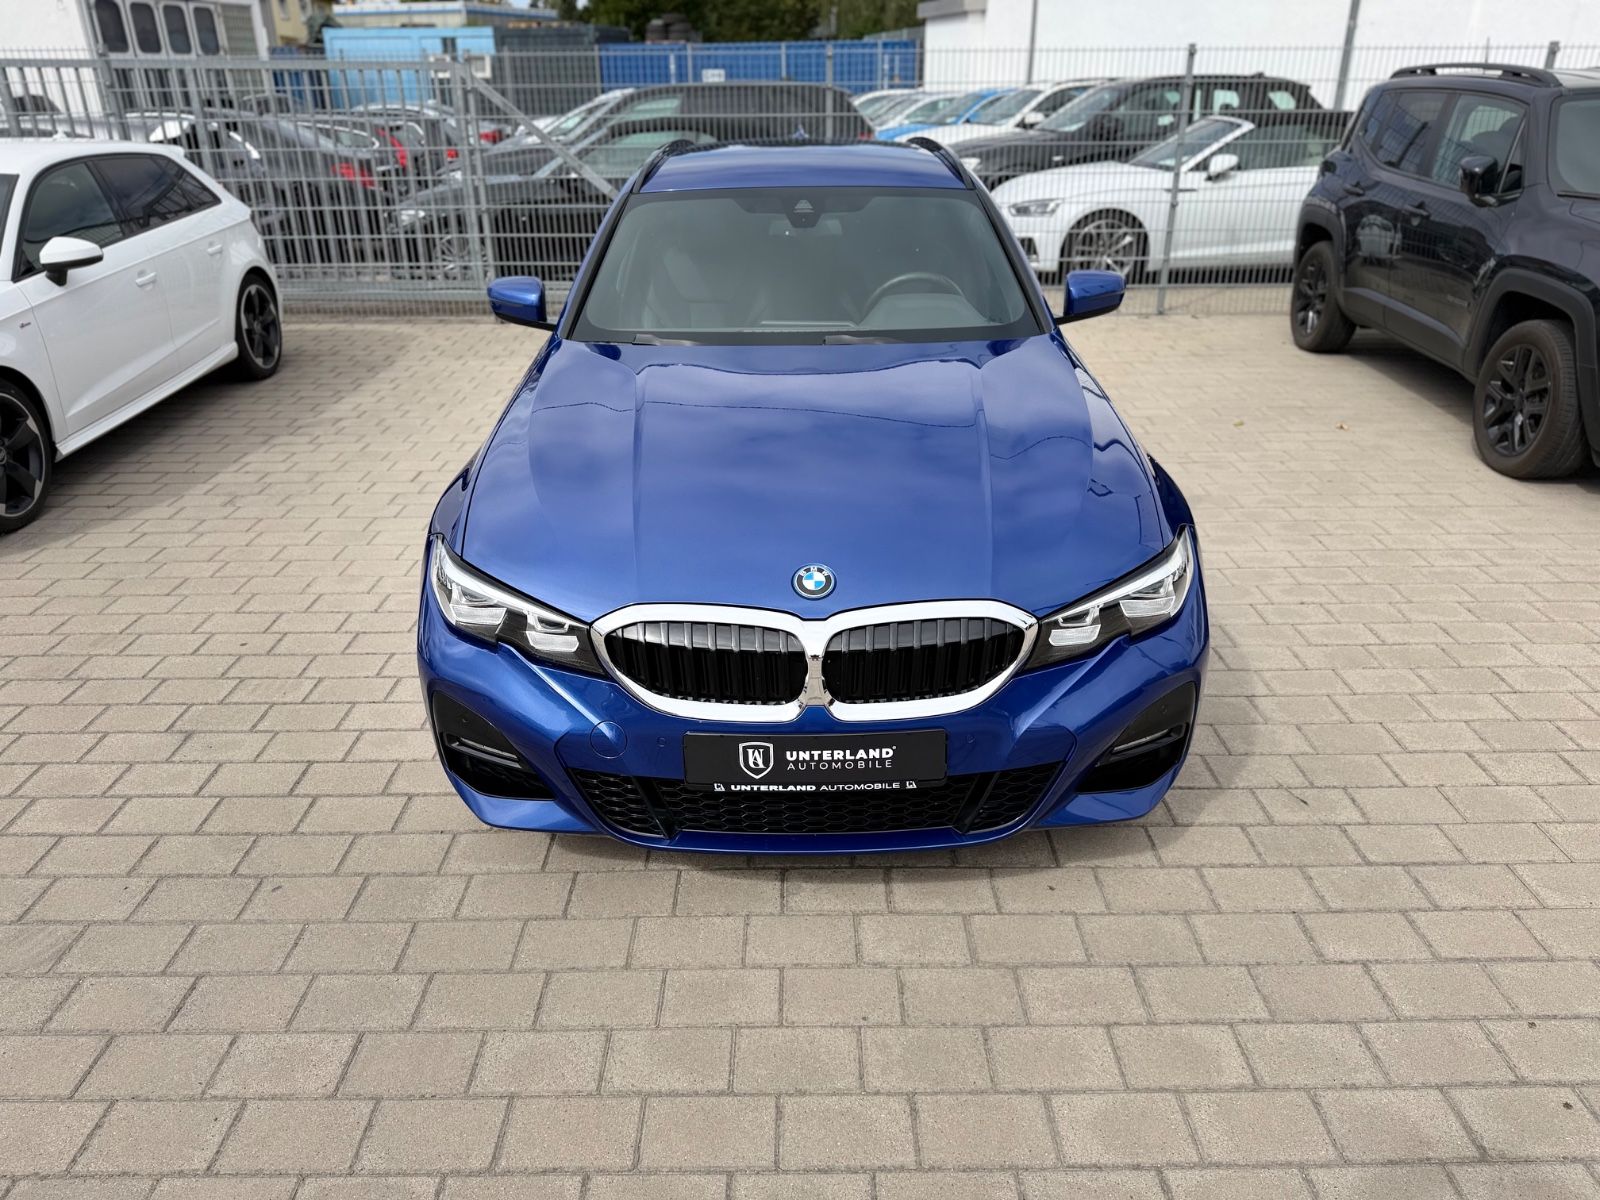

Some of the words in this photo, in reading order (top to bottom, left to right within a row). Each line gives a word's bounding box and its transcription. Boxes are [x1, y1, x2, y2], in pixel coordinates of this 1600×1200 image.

[785, 748, 894, 761] UNTERLAND
[786, 760, 892, 770] AUTOMOBILE
[730, 784, 817, 792] UNTERLAND
[820, 782, 901, 792] AUTOMOBILE
